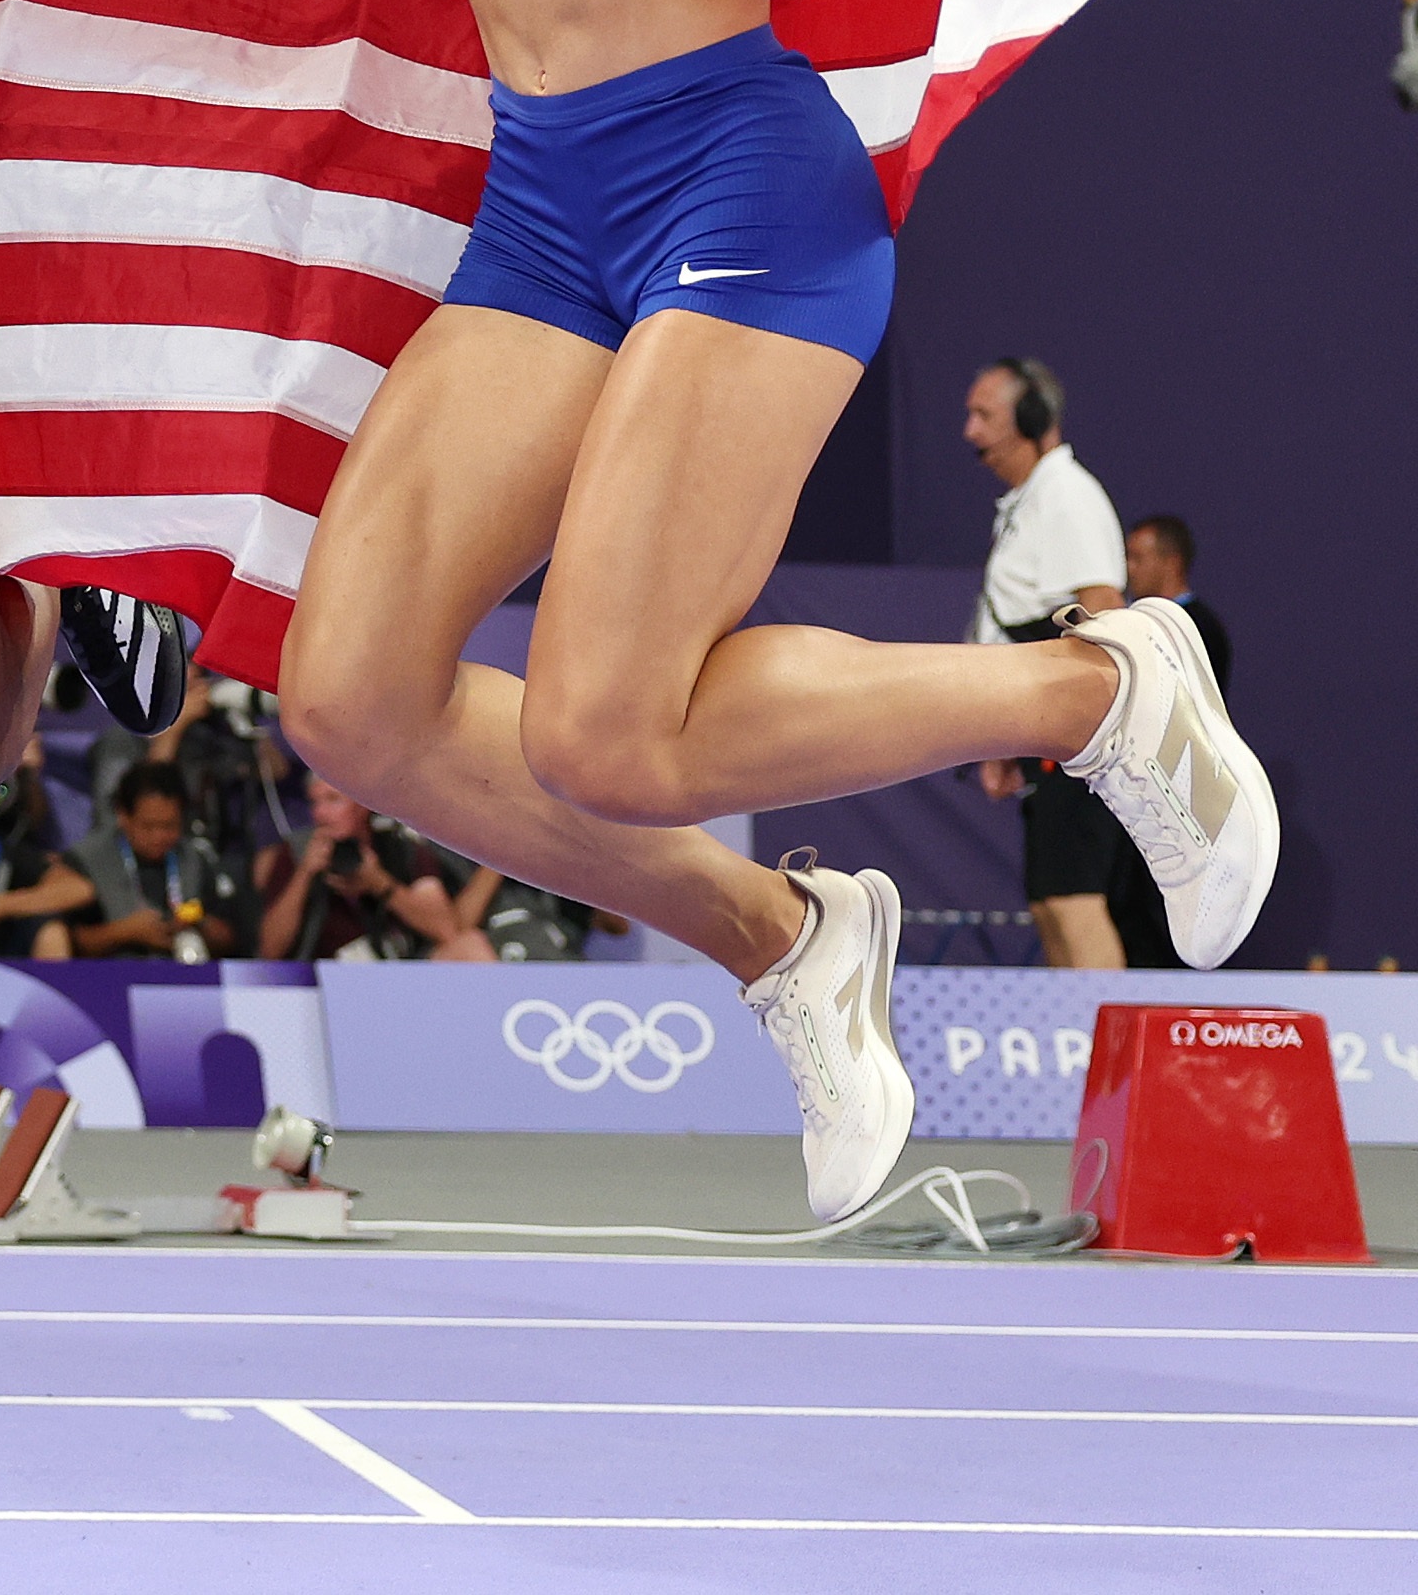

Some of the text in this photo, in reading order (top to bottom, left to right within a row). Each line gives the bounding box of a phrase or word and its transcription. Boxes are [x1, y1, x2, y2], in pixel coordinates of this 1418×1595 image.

[945, 1026, 1418, 1083] PAR 24
[1199, 1020, 1303, 1049] OMEGA
